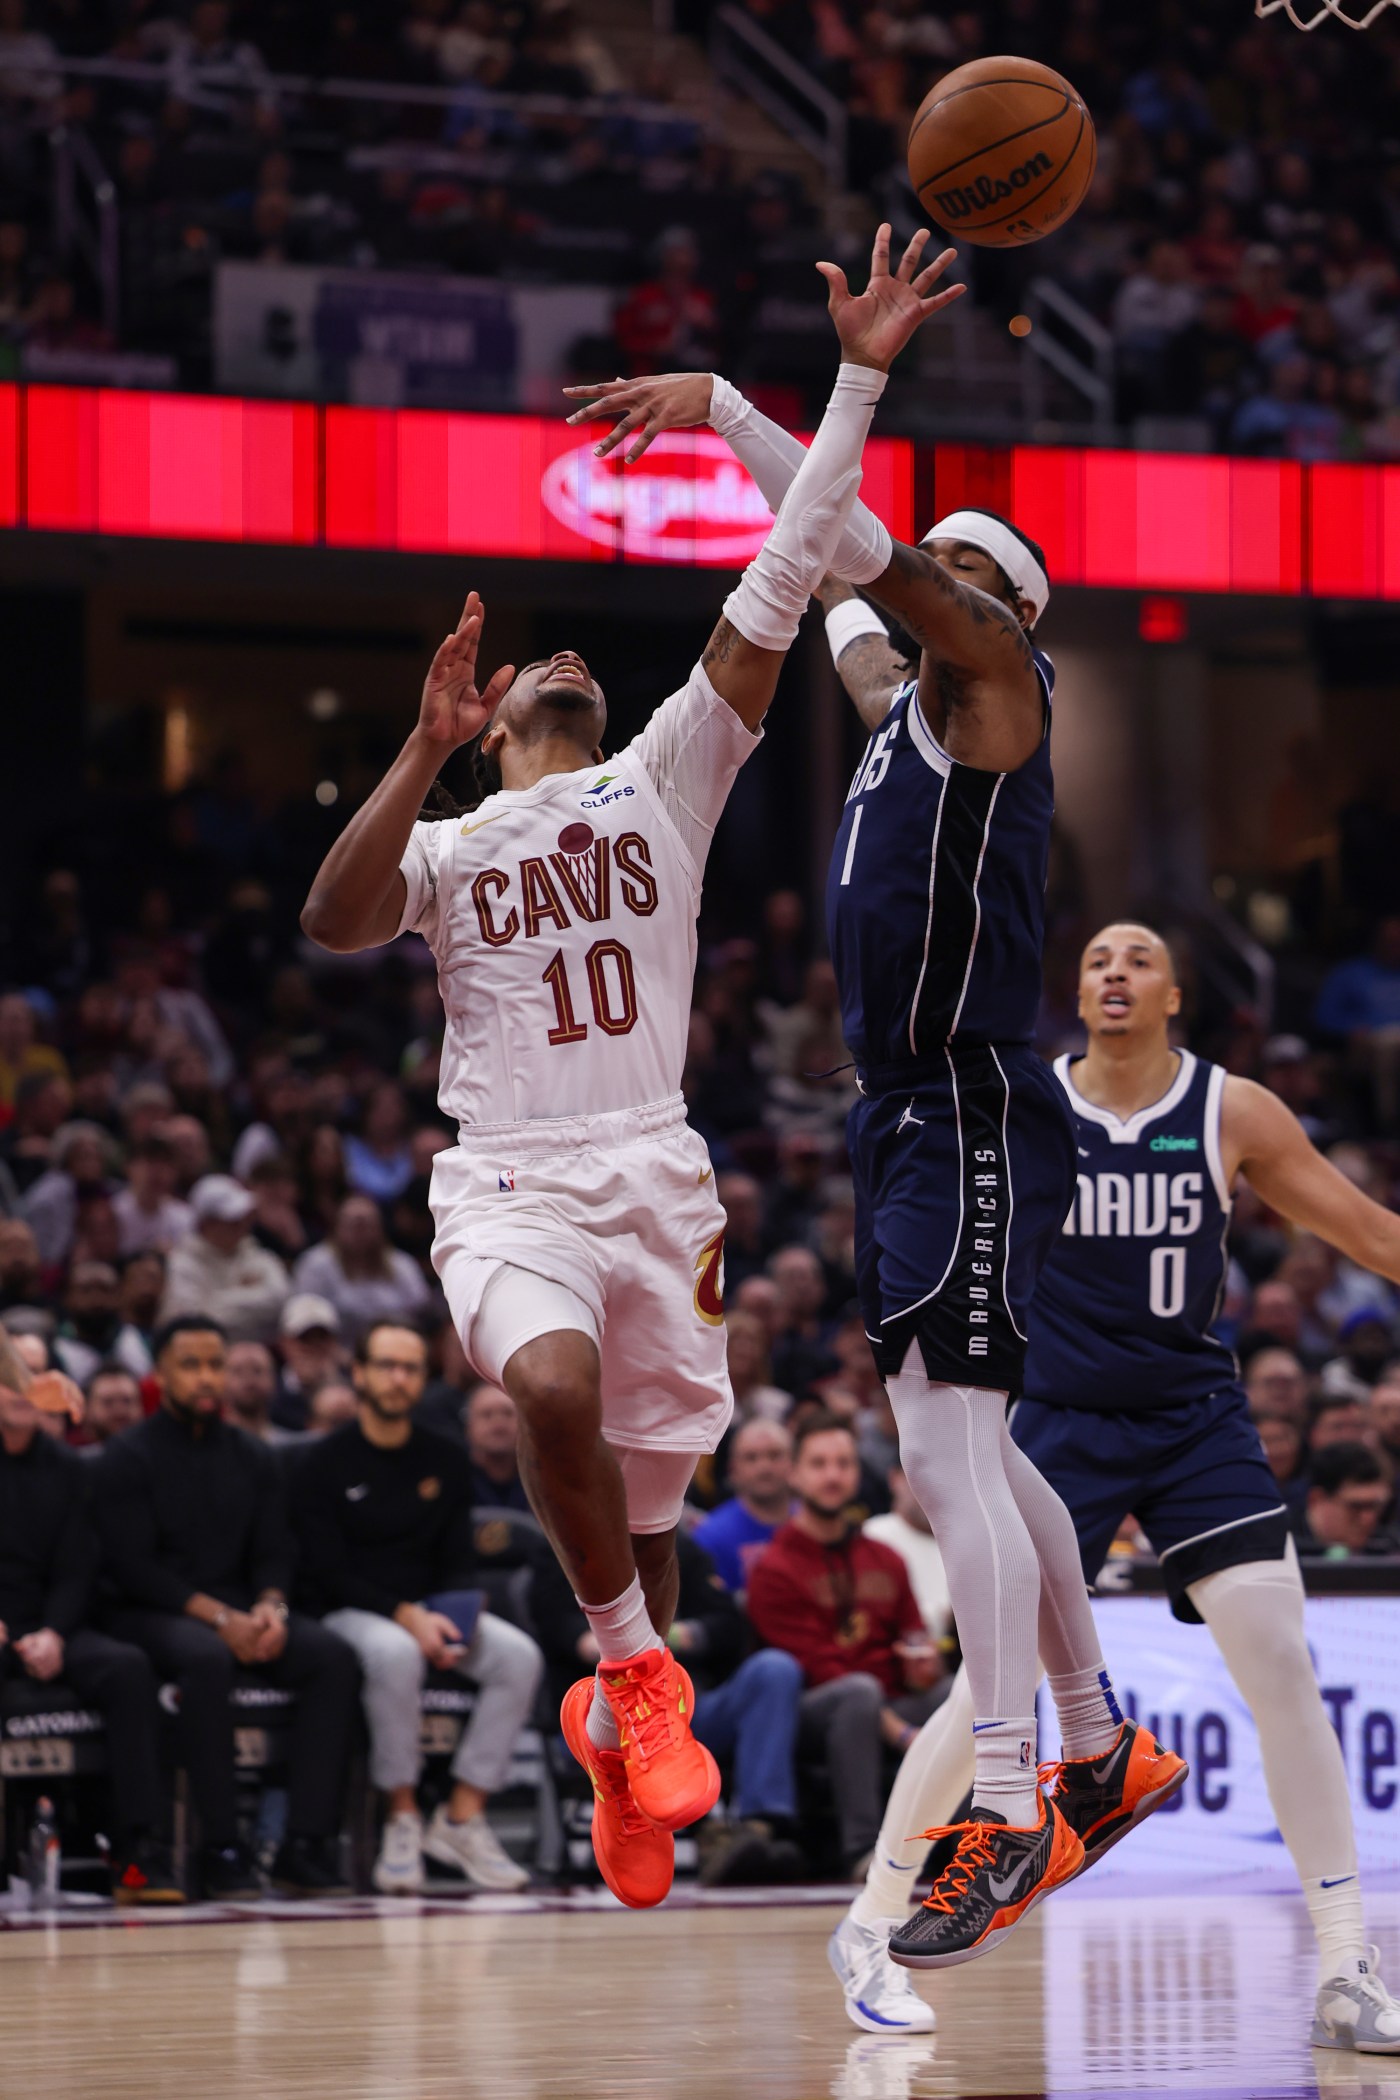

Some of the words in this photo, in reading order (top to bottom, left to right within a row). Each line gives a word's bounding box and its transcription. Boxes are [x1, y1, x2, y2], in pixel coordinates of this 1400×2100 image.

[932, 151, 1054, 220] Wilson
[580, 785, 636, 809] CLIFFS
[843, 719, 901, 806] AVS
[840, 803, 864, 886] 1
[471, 831, 659, 948] CAVS
[541, 938, 639, 1046] 10
[1150, 1135, 1198, 1152] chime
[968, 1148, 998, 1357] MAVERICKS
[1149, 1246, 1187, 1318] 0
